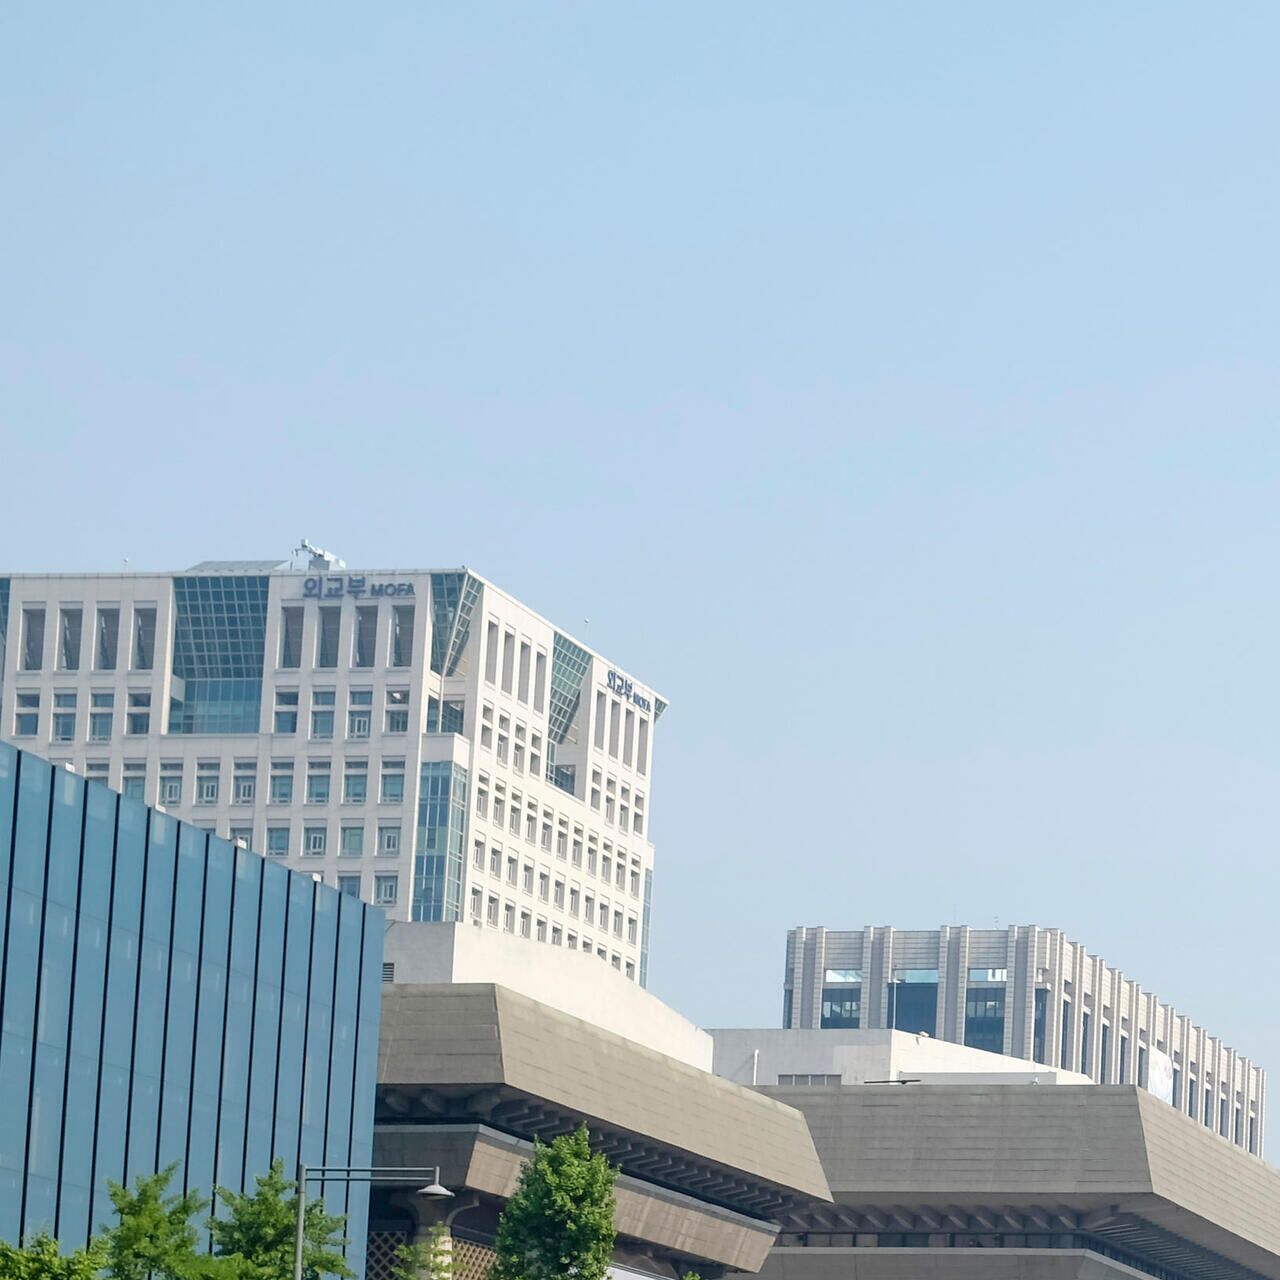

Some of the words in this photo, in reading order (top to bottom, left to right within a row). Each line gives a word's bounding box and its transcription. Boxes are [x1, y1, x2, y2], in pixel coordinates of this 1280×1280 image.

[303, 576, 366, 598] 외교부
[371, 584, 415, 597] MOFA
[607, 670, 633, 701] 외교부
